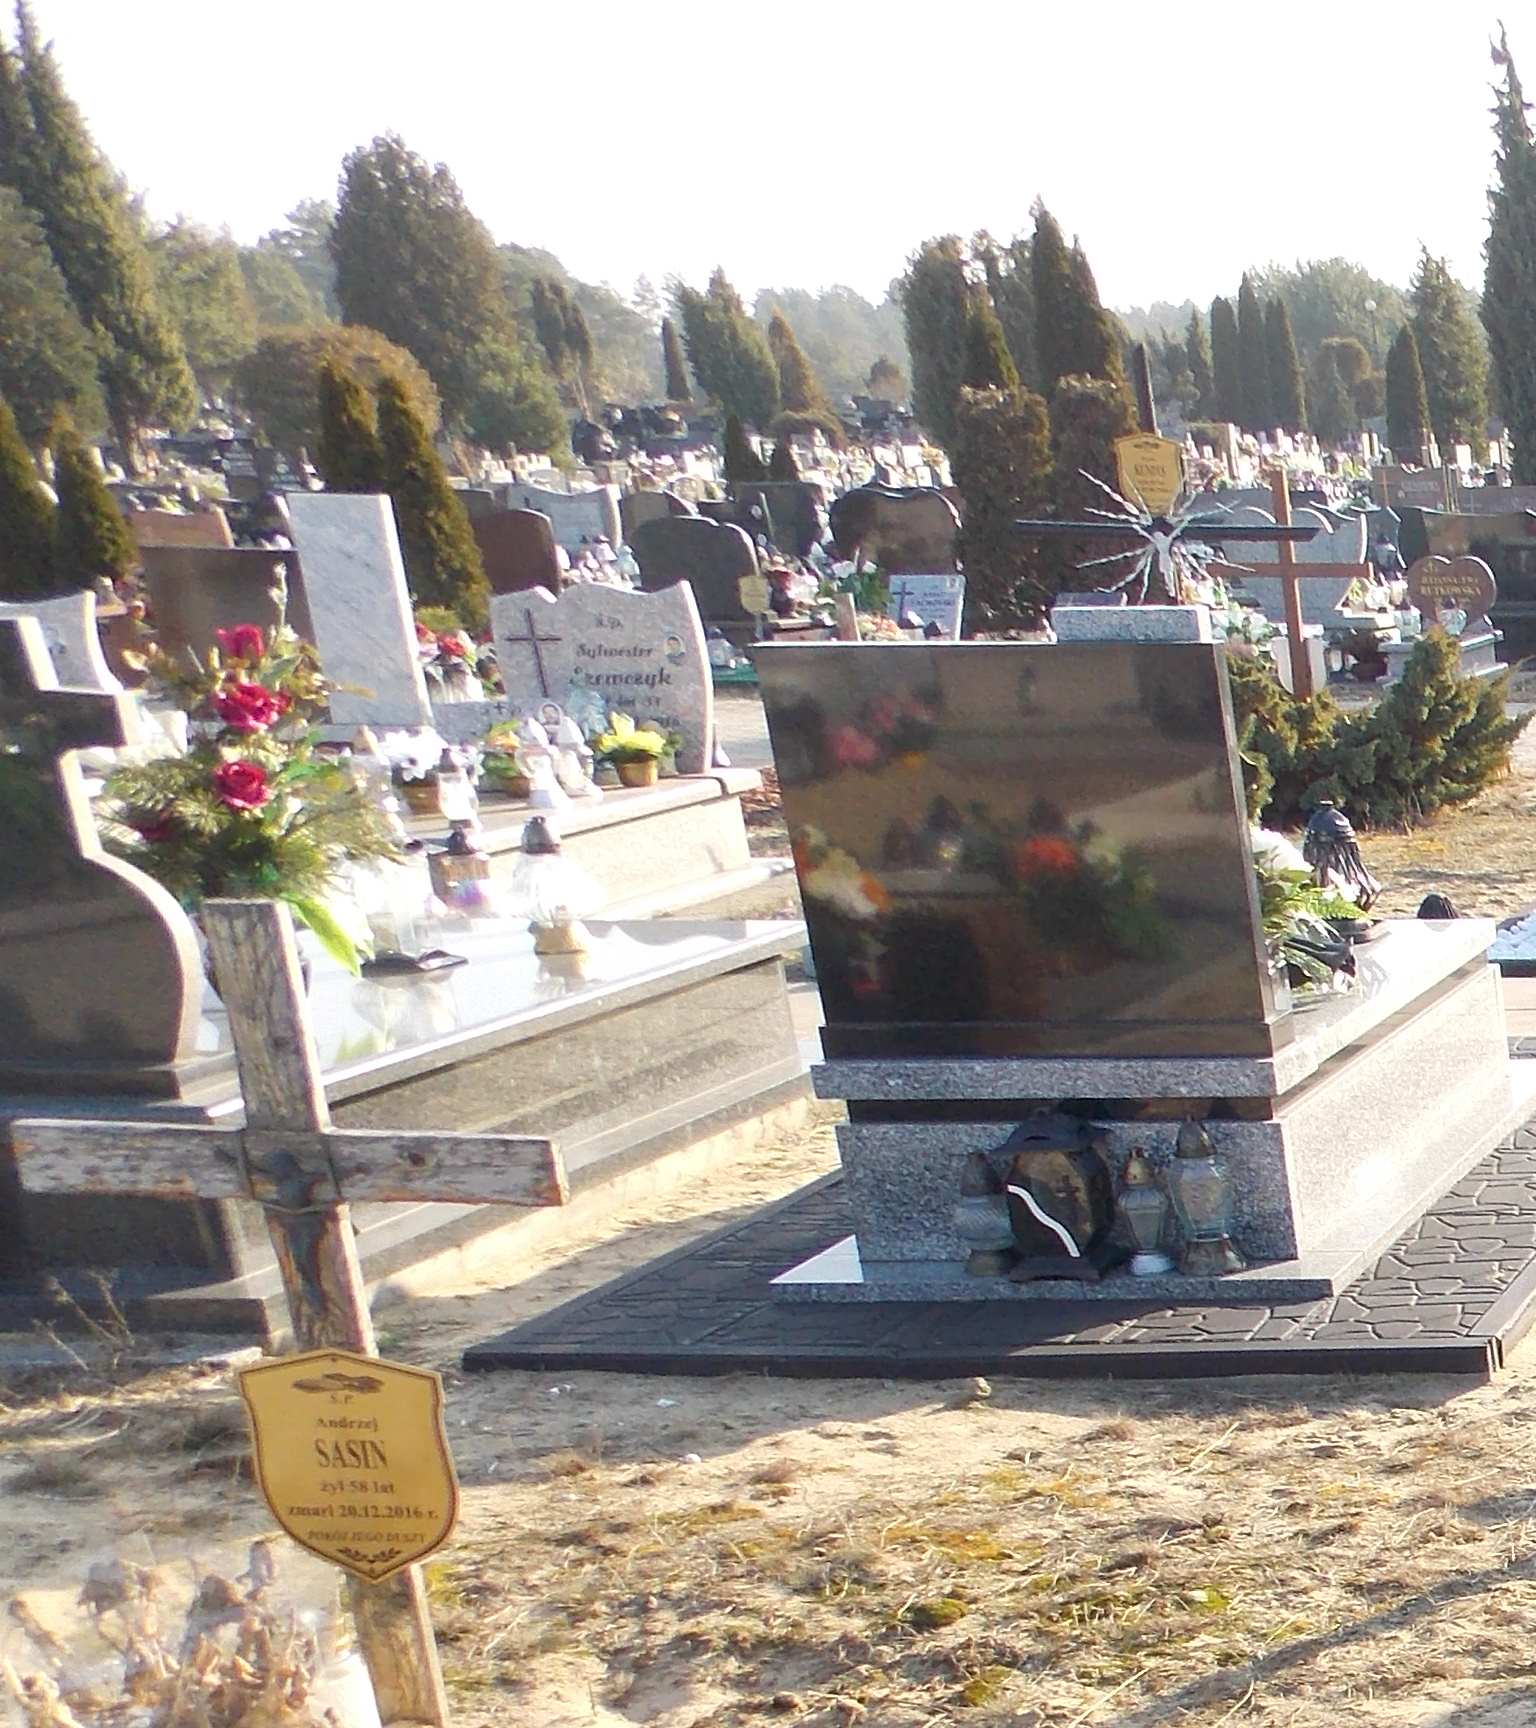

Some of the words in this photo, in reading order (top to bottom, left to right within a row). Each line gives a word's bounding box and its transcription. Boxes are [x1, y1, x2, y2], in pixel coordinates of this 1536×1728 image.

[317, 1416, 378, 1432] Andrzej
[314, 1439, 389, 1470] SASIN
[374, 1481, 395, 1494] lat
